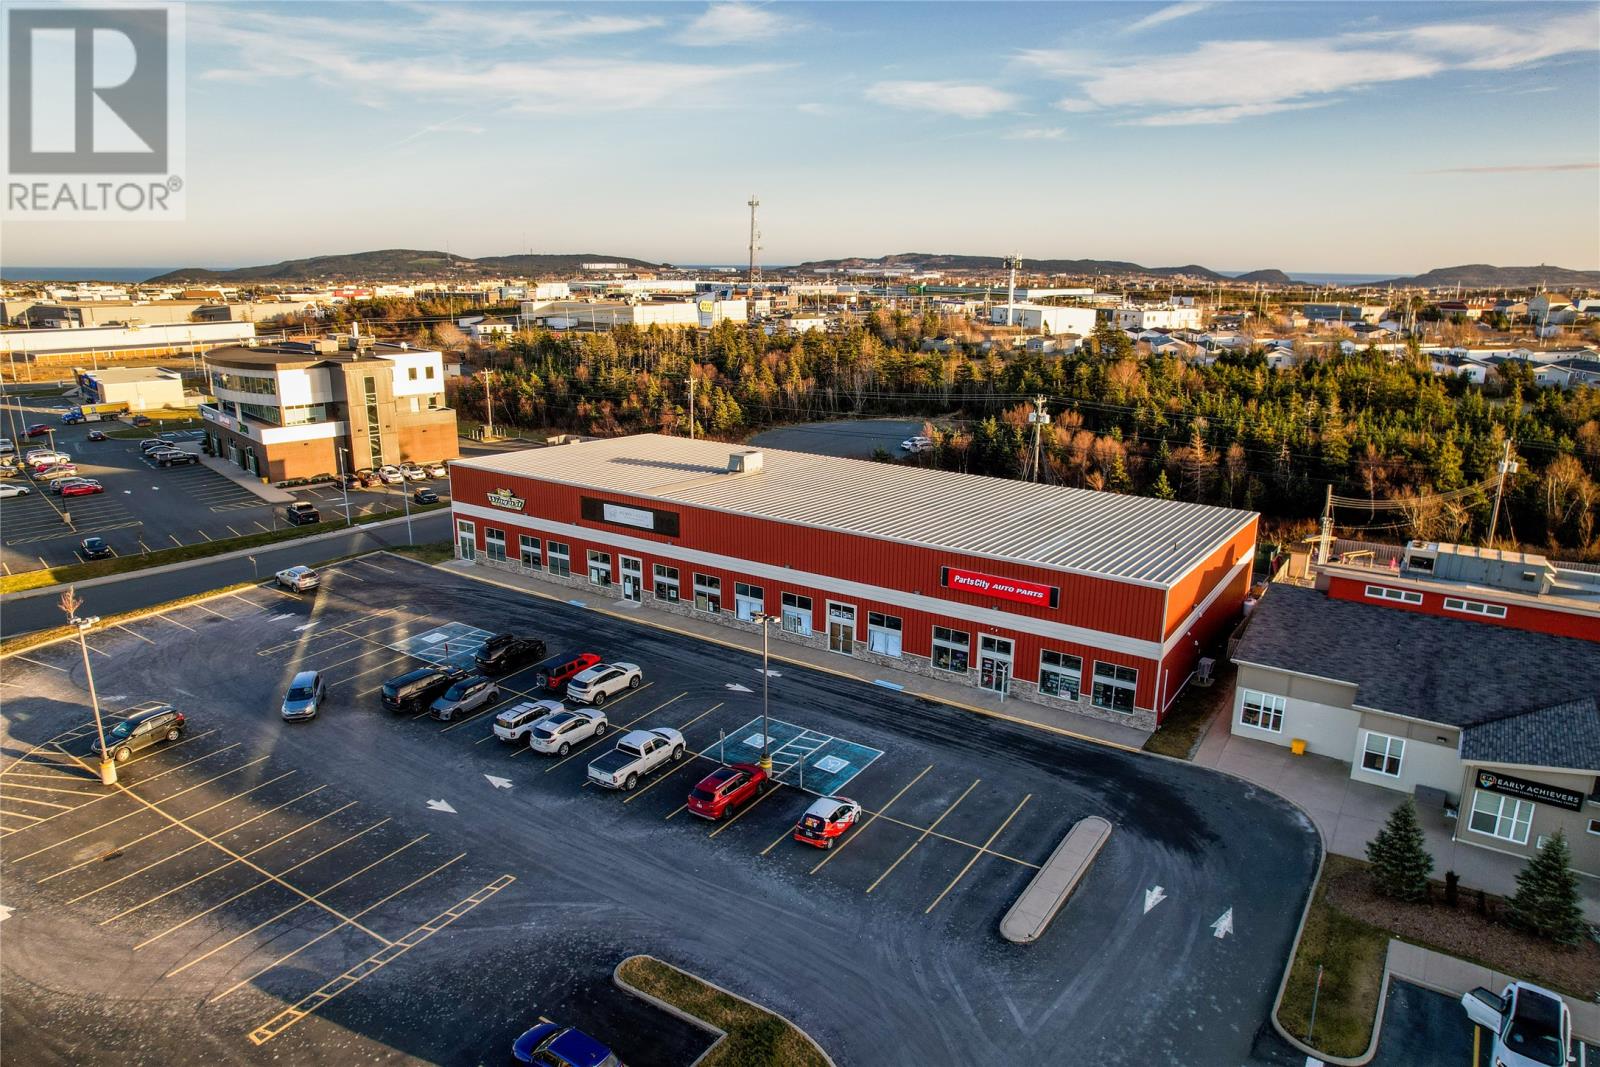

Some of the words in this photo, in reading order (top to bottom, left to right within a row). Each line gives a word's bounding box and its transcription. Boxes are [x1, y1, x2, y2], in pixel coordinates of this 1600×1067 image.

[954, 575, 990, 590] PartsCity
[992, 583, 1014, 593] AUTO
[1016, 588, 1044, 598] PARTS
[1497, 779, 1526, 791] EARLY
[1526, 785, 1579, 803] ACHIEVERS
